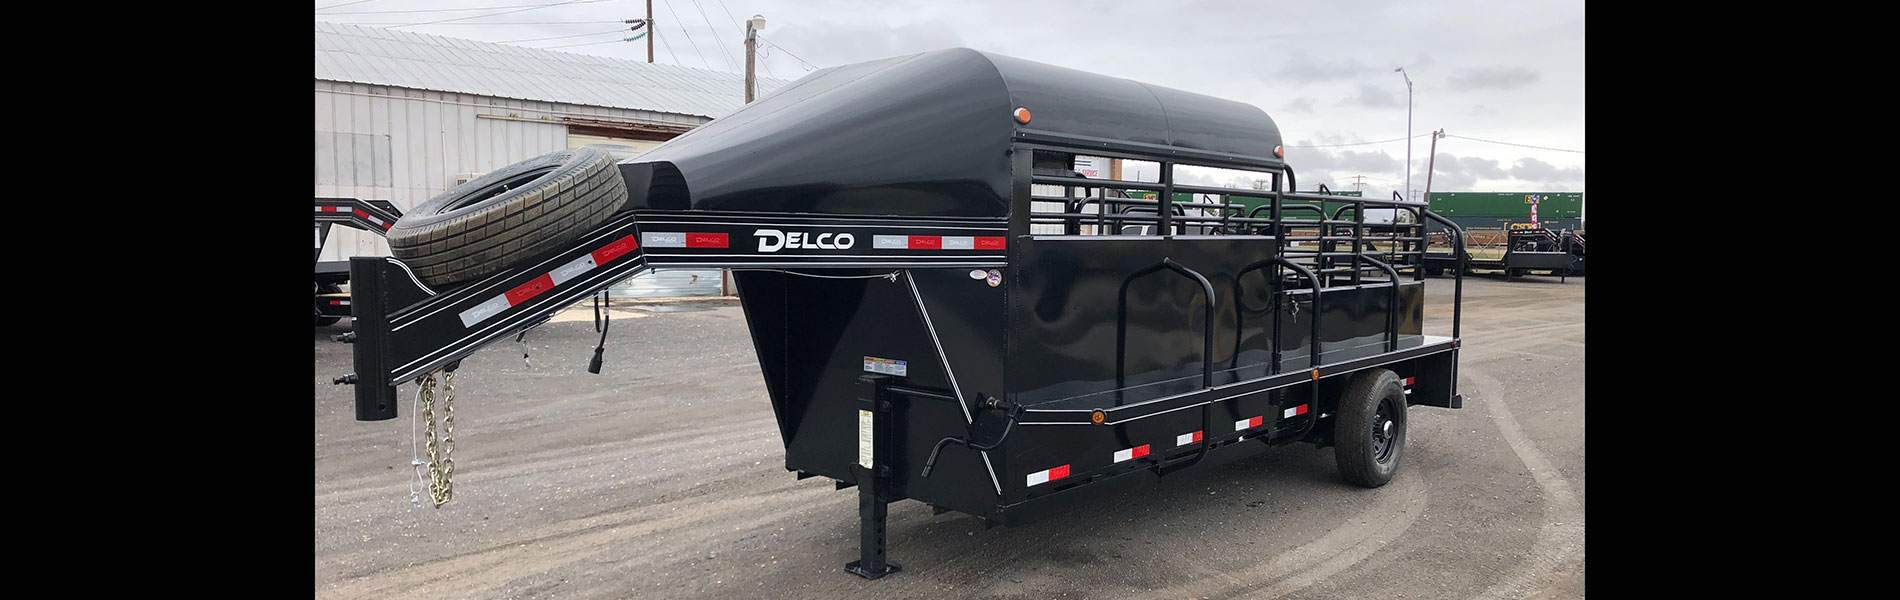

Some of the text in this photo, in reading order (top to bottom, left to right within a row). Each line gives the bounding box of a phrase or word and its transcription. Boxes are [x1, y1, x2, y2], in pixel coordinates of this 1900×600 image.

[753, 229, 855, 252] DELCO
[560, 262, 587, 277] DELCO
[471, 302, 499, 318] DELCO
